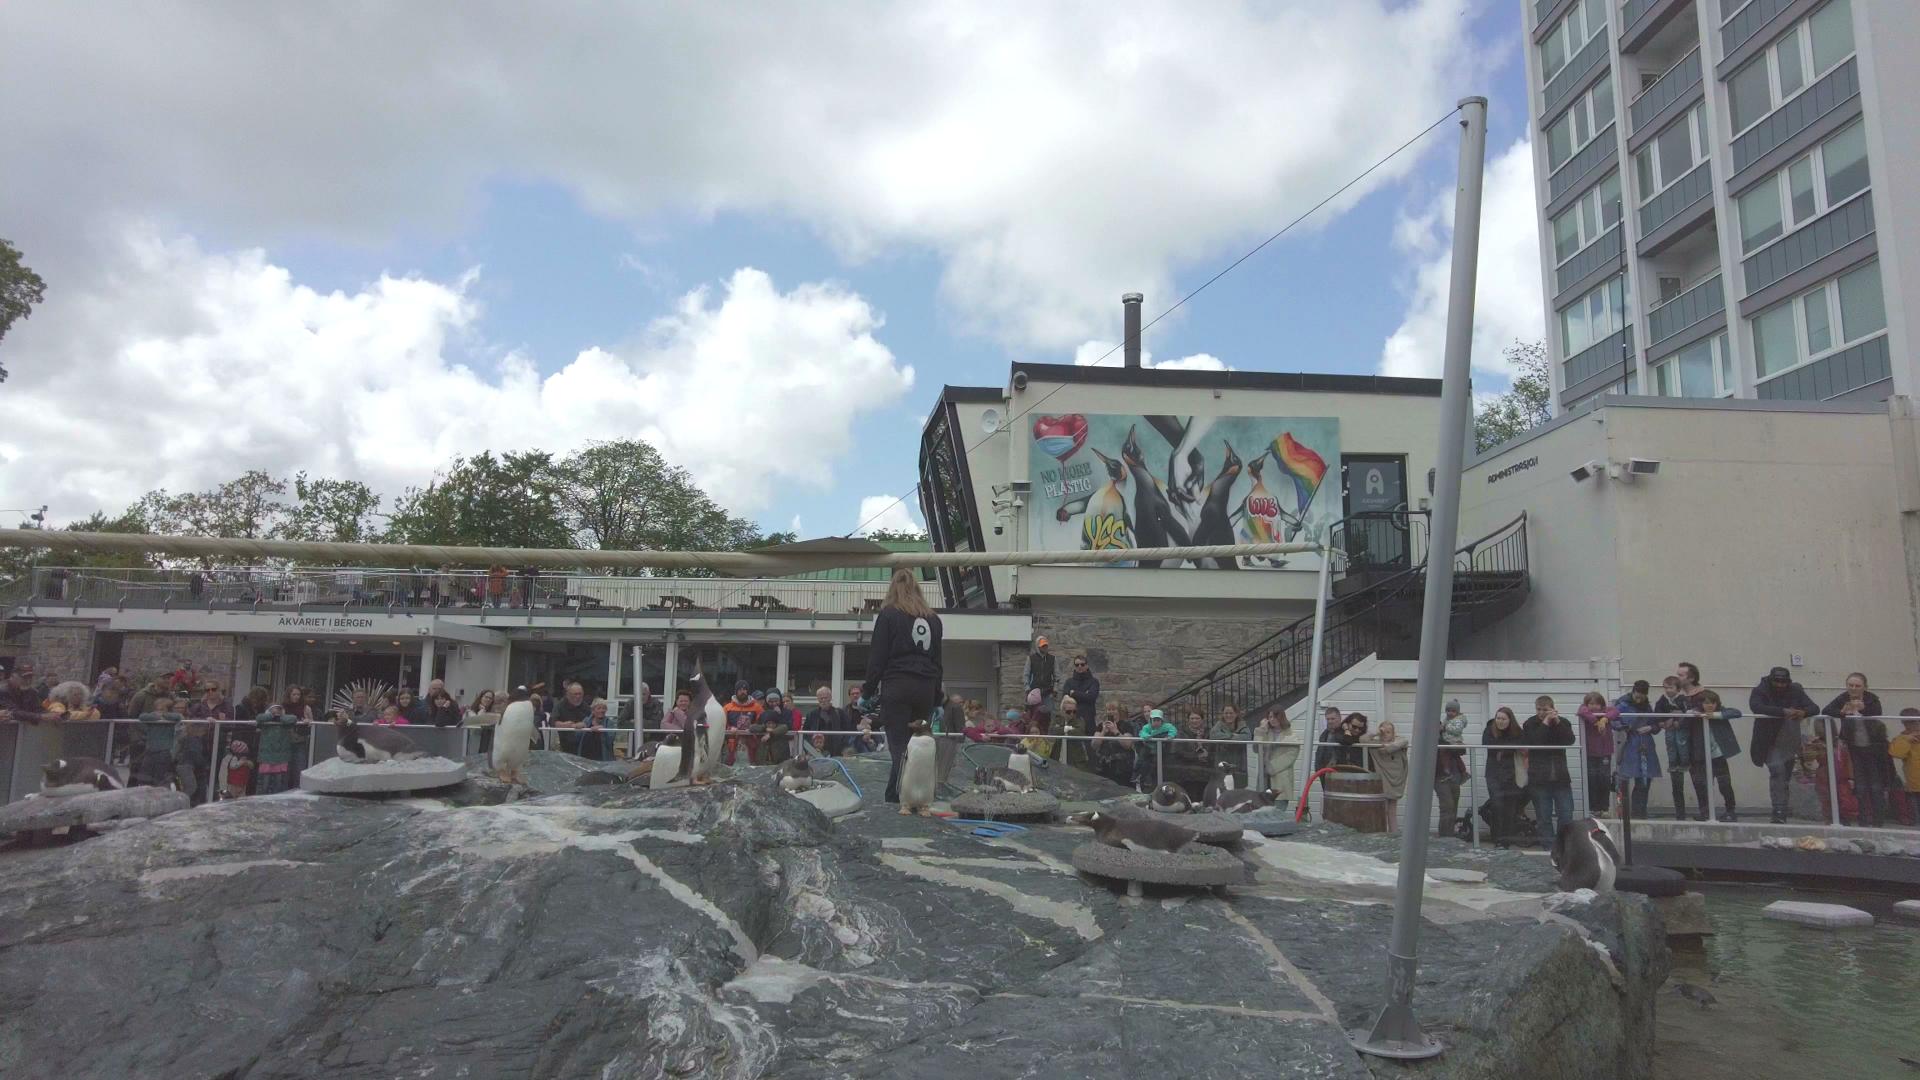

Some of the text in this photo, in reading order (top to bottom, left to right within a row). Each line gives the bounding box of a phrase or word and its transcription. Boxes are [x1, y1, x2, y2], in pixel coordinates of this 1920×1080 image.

[1041, 462, 1092, 484] NO MORE
[1045, 478, 1091, 497] PLASTIC
[279, 616, 326, 627] AKVARIET
[334, 618, 373, 628] BERGEN
